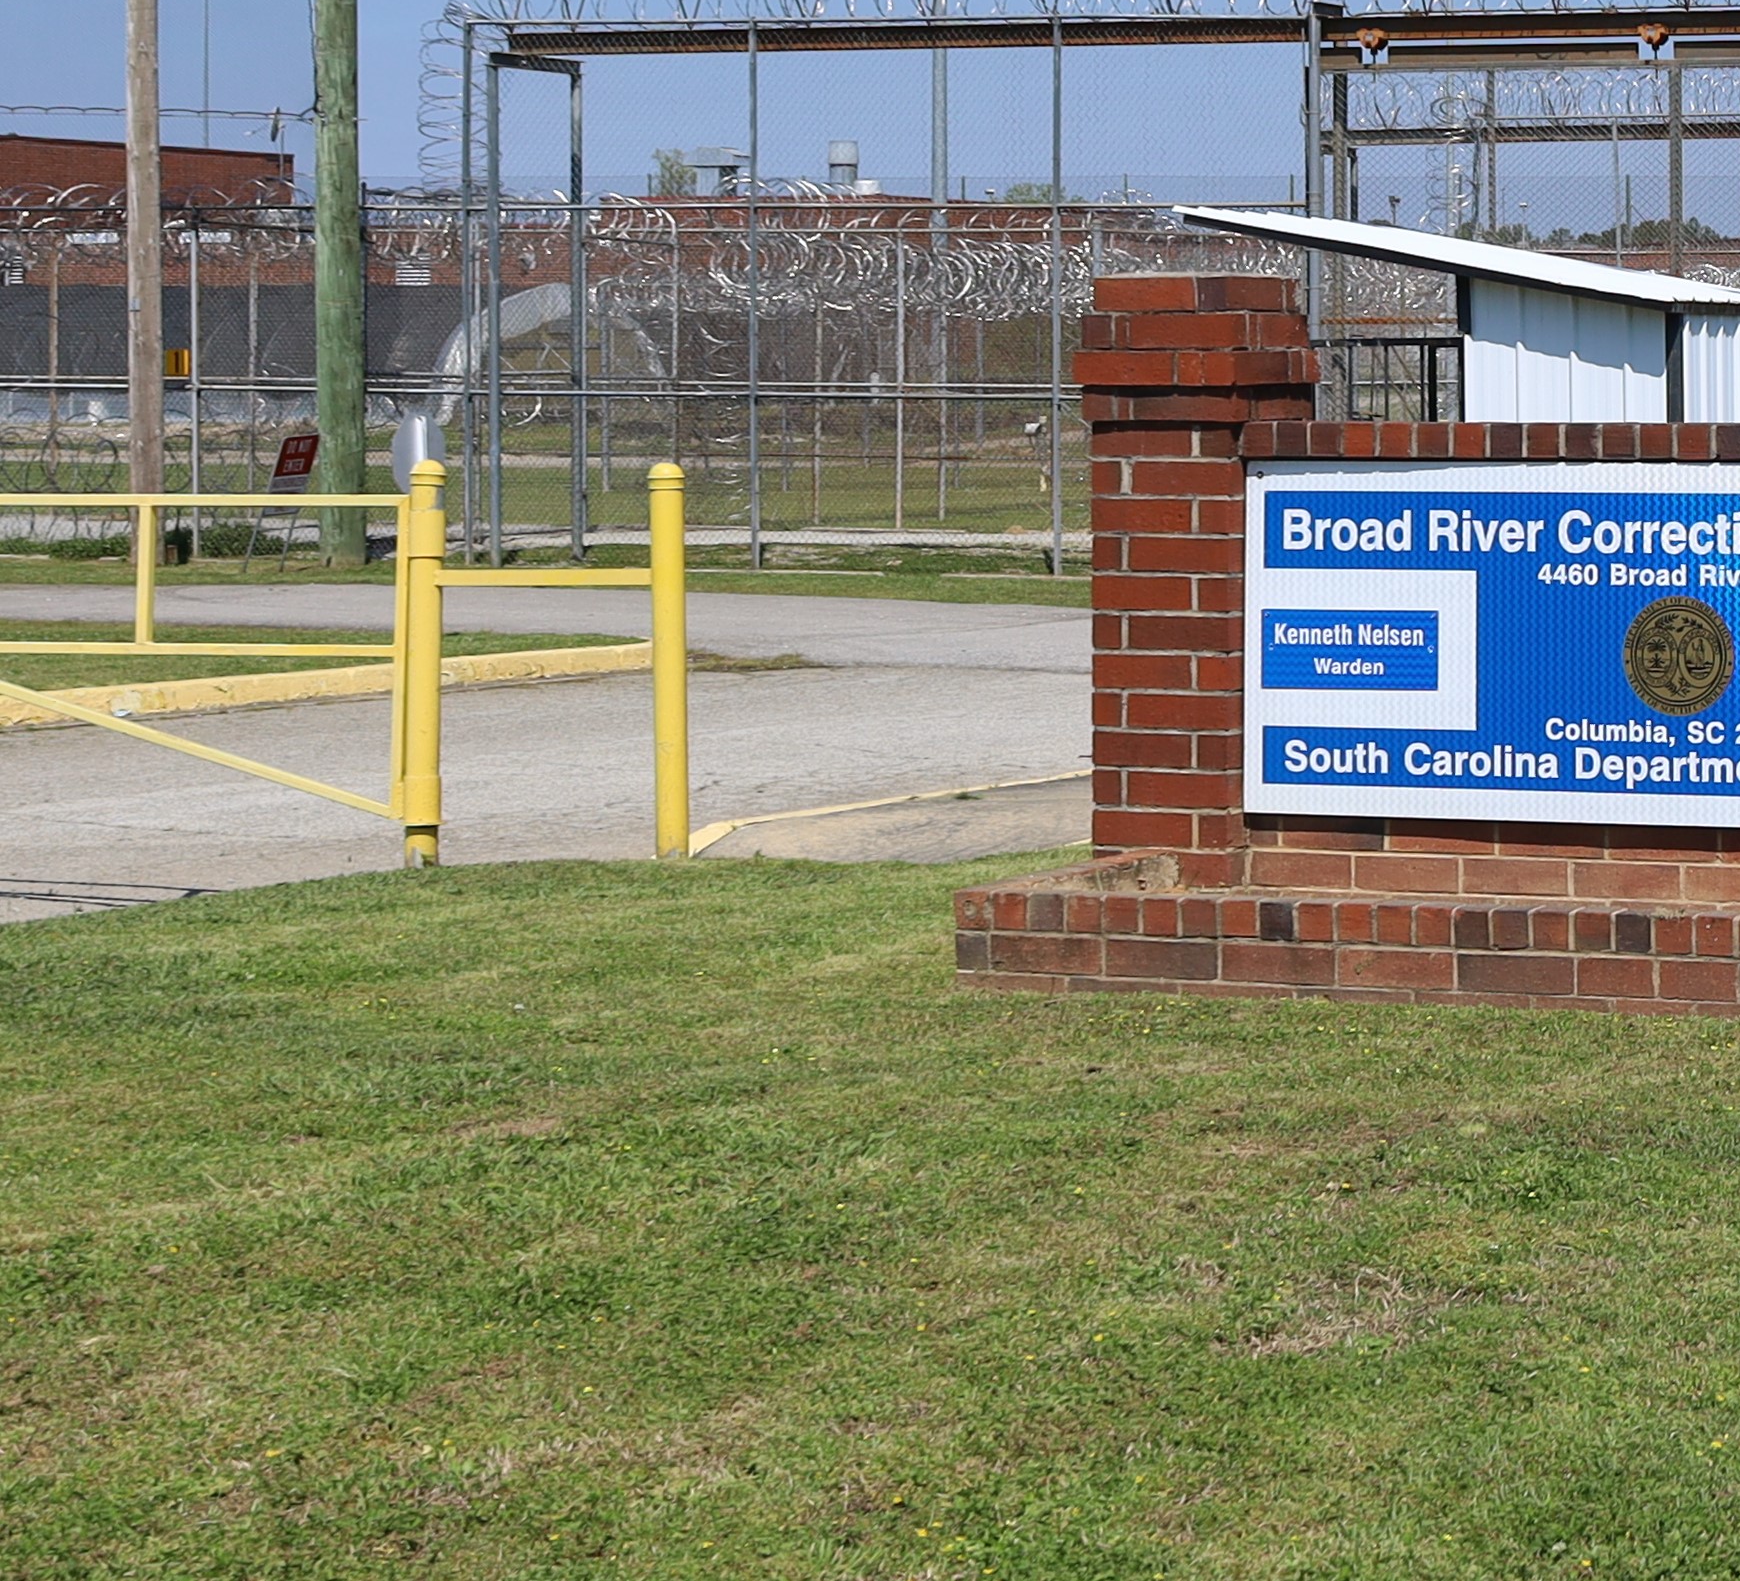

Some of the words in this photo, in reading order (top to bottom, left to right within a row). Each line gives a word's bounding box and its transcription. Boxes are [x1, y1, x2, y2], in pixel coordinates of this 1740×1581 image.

[1281, 508, 1412, 552] Broad
[1428, 509, 1544, 553] River
[1538, 563, 1598, 586] 4460
[1610, 564, 1687, 587] Broad
[1274, 623, 1352, 645] Kenneth
[1358, 624, 1424, 647] Nelsen
[1314, 658, 1384, 675] Warden
[1545, 717, 1676, 747] Columbia,
[1687, 721, 1725, 745] SC
[1284, 739, 1389, 774] South
[1404, 742, 1559, 779] Carolina
